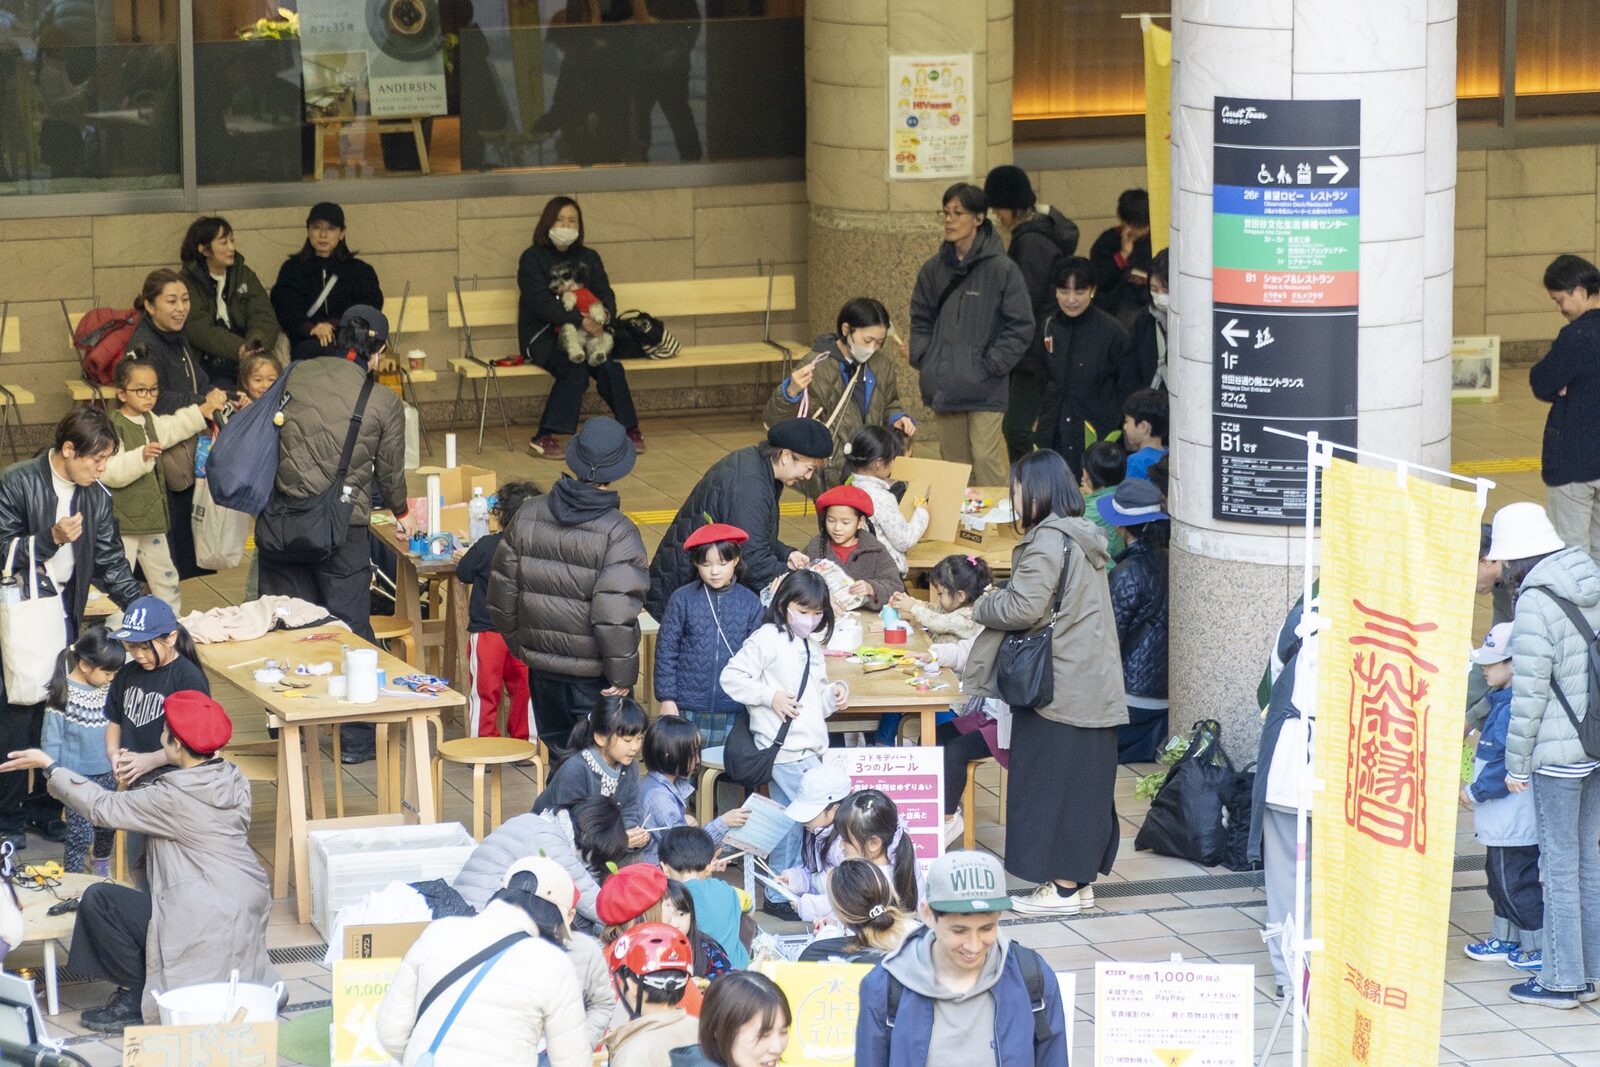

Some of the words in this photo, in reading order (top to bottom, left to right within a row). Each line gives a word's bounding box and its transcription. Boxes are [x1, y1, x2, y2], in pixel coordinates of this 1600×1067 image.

[378, 82, 437, 94] ANDERSEN
[1244, 190, 1259, 200] 26F
[1264, 190, 1304, 201] 展望ロビー
[1310, 191, 1348, 201] レストラン
[1244, 218, 1348, 230] 世田谷文化生活情報センター
[1245, 273, 1257, 283] B1
[1264, 274, 1335, 284] ショップ&レストラン
[1221, 351, 1239, 370] 1F
[1221, 374, 1304, 388] 世田谷通り側エントランス
[1221, 392, 1246, 403] オフィス
[1221, 422, 1240, 432] ここは
[1220, 433, 1241, 452] B1
[1243, 443, 1257, 453] です
[856, 763, 918, 773] 3つのルール
[950, 867, 995, 892] WILD
[1155, 994, 1185, 1002] PayPay
